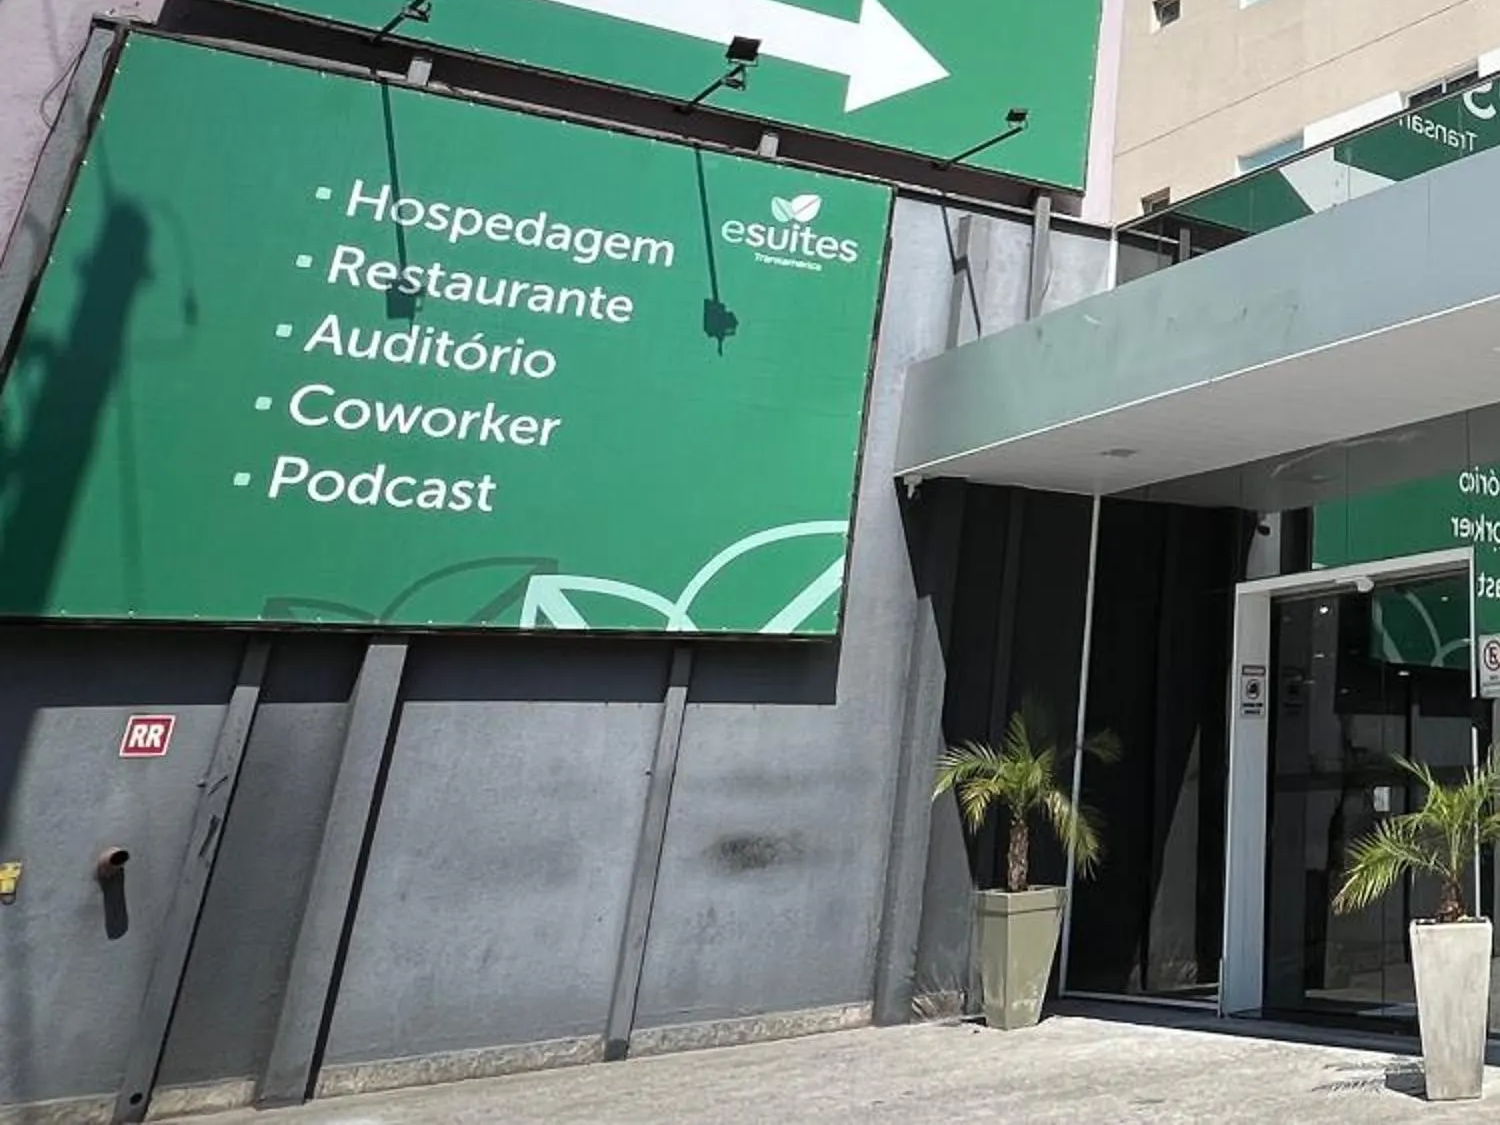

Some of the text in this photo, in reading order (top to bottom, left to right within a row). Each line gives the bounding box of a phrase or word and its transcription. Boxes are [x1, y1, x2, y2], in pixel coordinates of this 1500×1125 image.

[346, 178, 675, 268] Hospedagem
[721, 220, 859, 262] esuites
[327, 244, 634, 324] Restaurante
[303, 314, 557, 379] Auditório
[289, 383, 562, 447] Coworker
[268, 455, 497, 512] Podcast
[128, 723, 165, 748] RR
